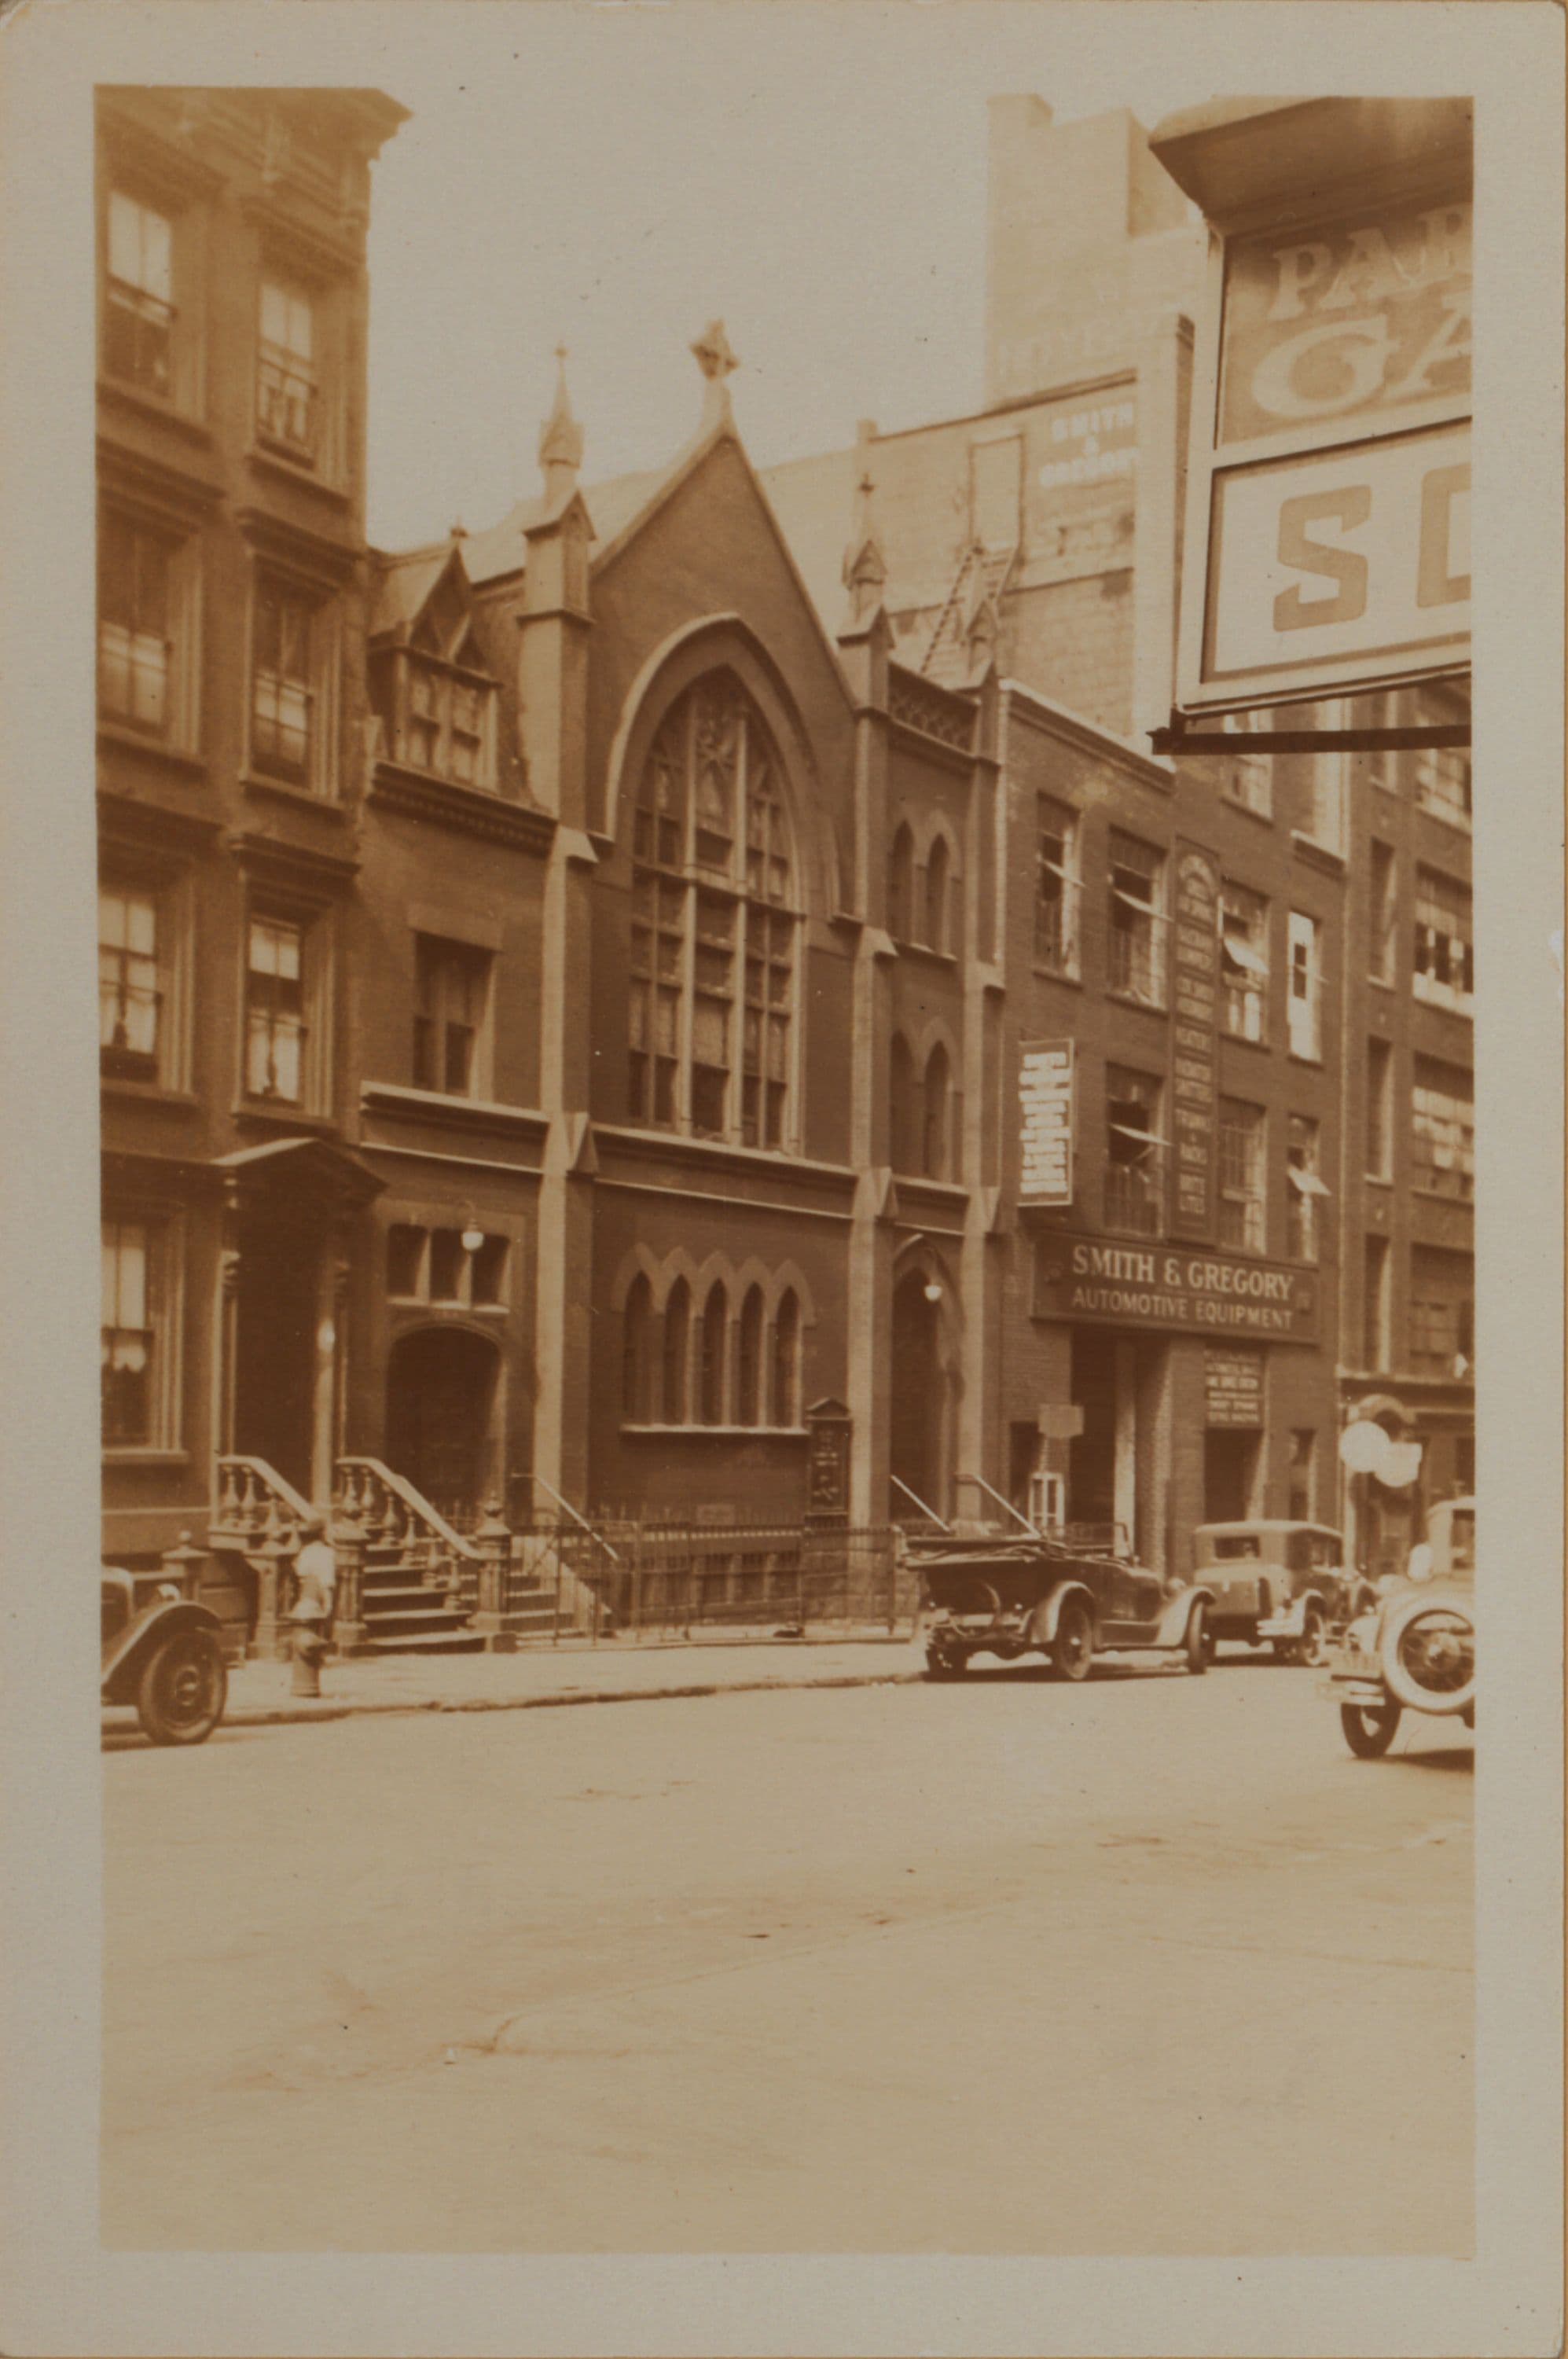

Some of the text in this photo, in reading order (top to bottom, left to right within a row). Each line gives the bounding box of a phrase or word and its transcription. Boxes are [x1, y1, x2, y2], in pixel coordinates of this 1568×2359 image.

[1072, 1244, 1296, 1302] SMITH & GREGORY
[1072, 1286, 1294, 1331] AUTOMOTIVE EQUIPMENT
